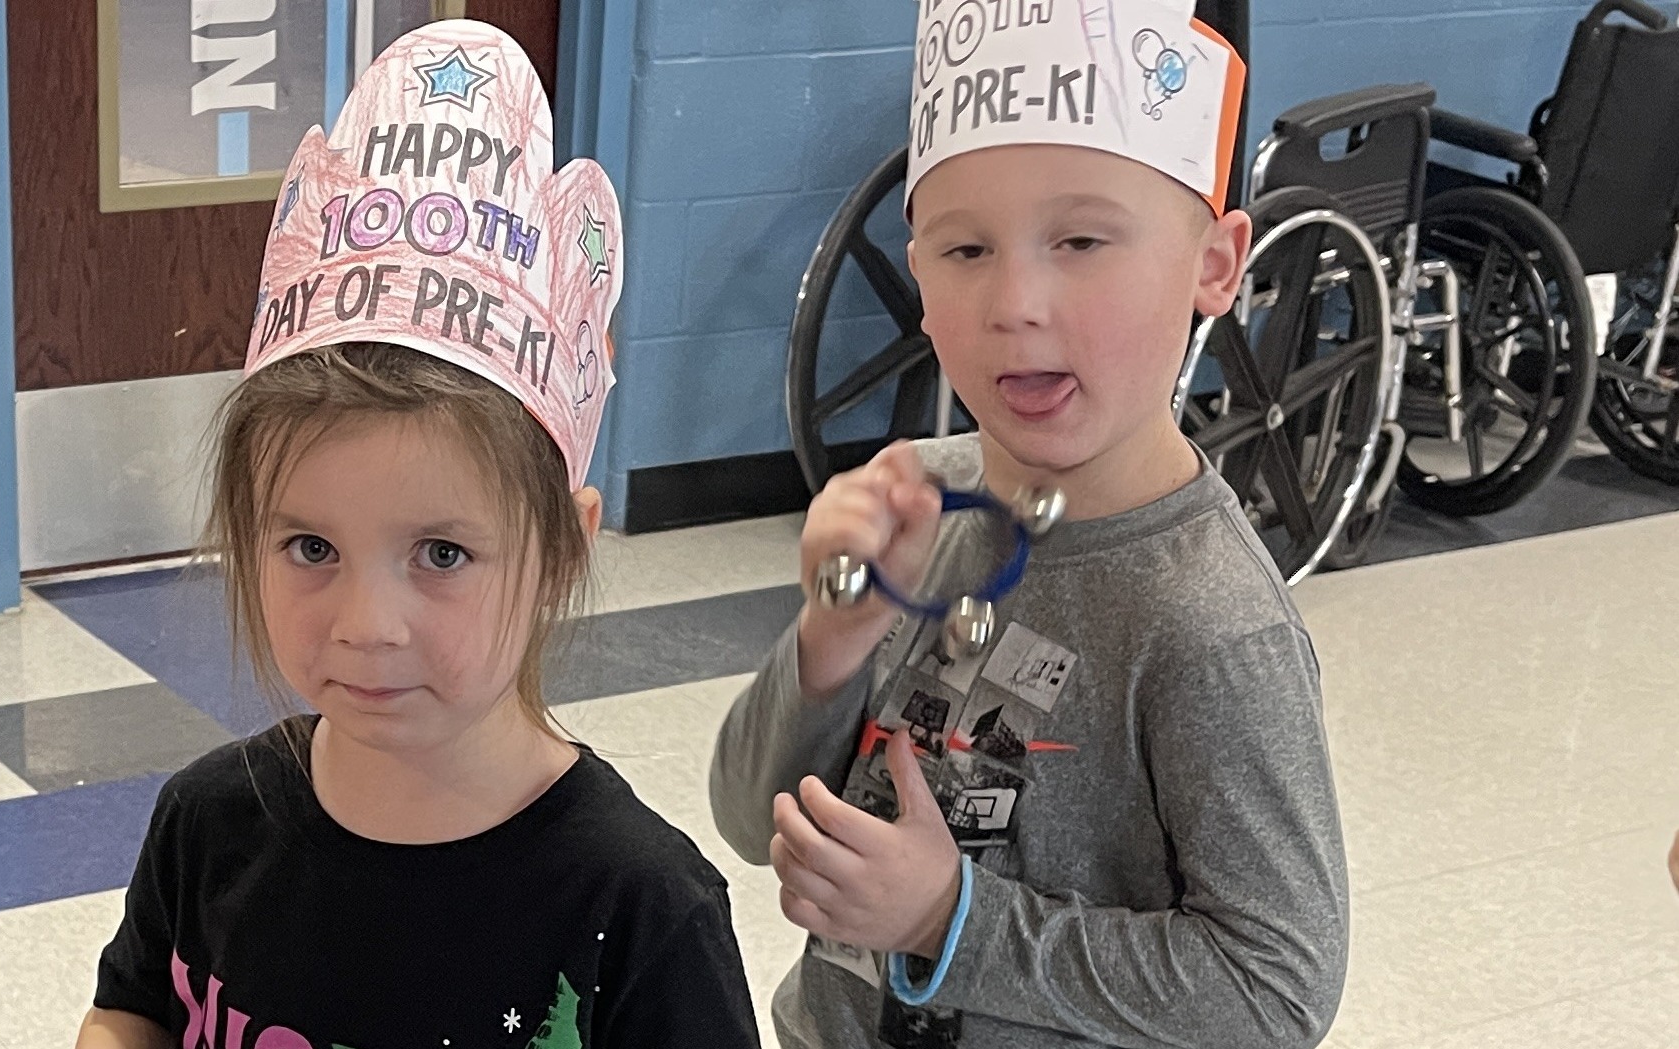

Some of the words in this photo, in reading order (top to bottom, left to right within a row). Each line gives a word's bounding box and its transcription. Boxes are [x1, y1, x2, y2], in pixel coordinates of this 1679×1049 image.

[915, 0, 1054, 89] 00TH
[918, 87, 944, 158] OF
[949, 63, 1097, 136] PRE-K!
[360, 123, 523, 196] HAPPY
[320, 187, 541, 270] 100TH
[258, 273, 325, 357] DAY
[334, 263, 401, 326] OF
[411, 267, 557, 394] PRE-K!
